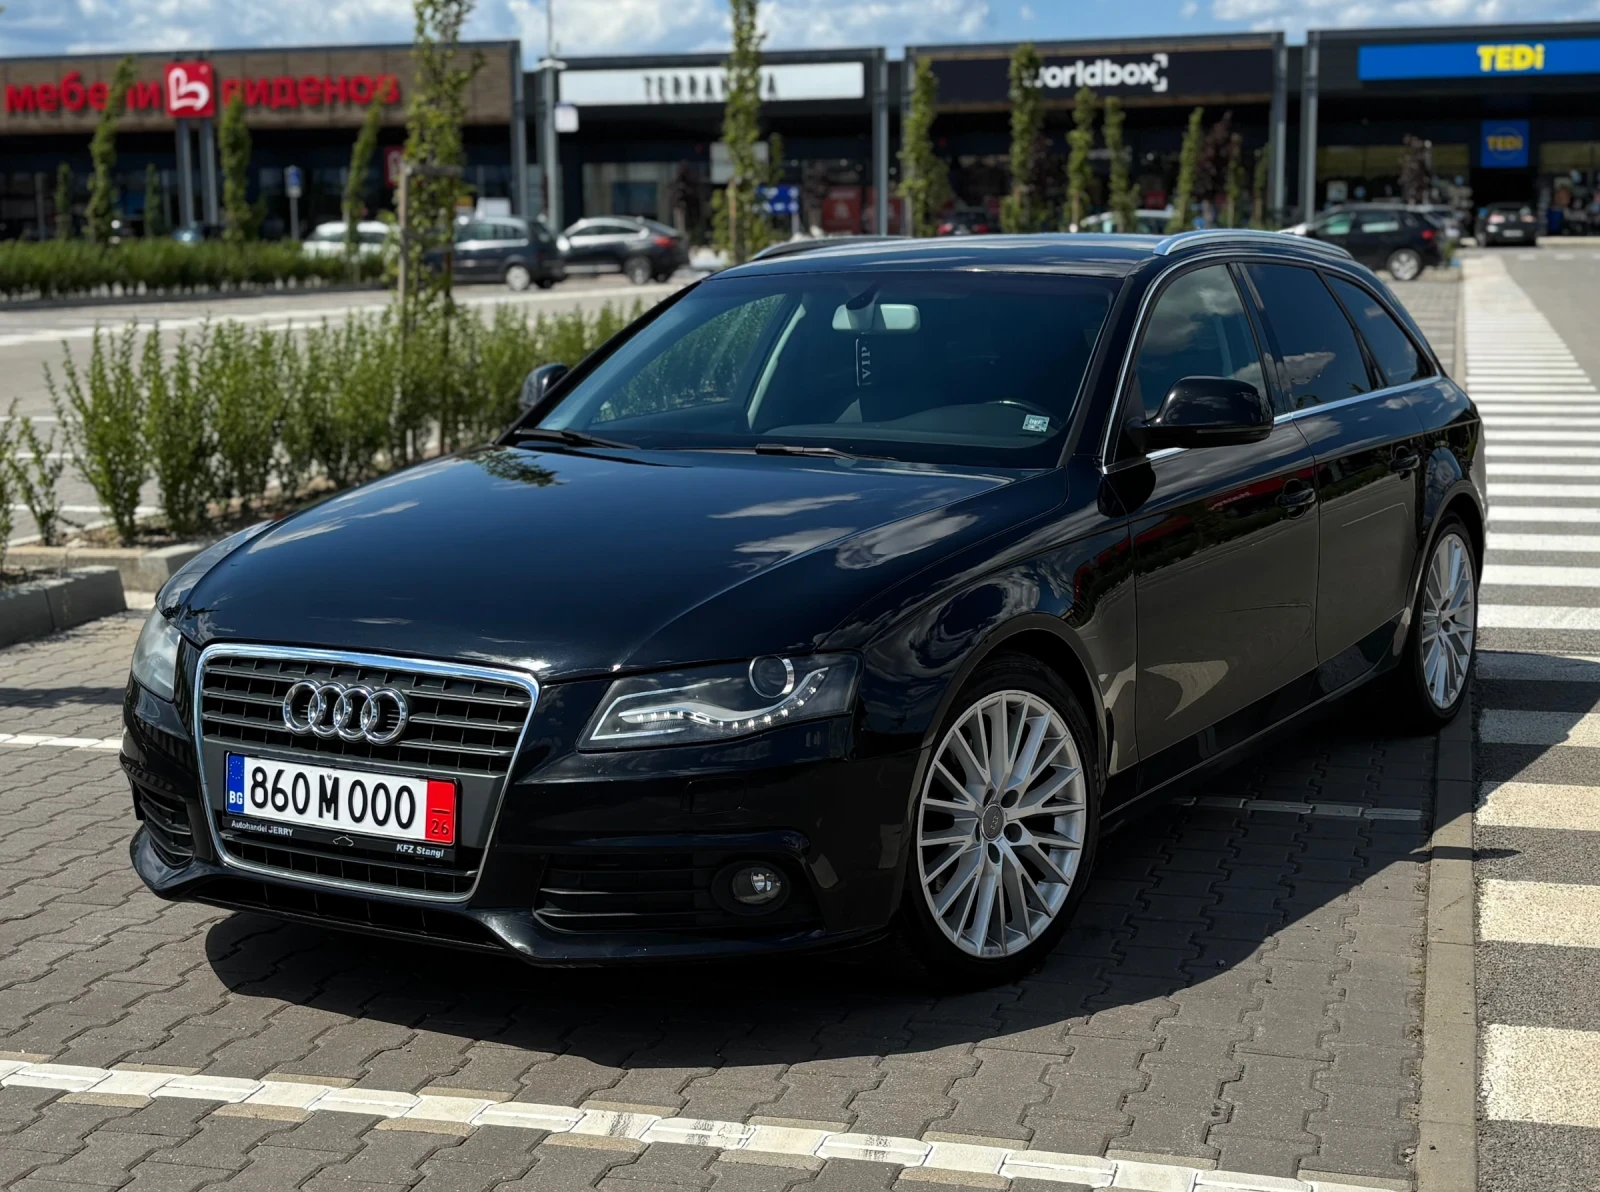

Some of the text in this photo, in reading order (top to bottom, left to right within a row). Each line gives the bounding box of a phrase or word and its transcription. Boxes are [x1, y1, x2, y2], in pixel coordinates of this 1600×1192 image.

[1477, 44, 1545, 71] TEDi
[643, 73, 779, 101] TERRAA
[229, 790, 243, 805] BG
[250, 766, 416, 830] 860 M 000
[231, 819, 294, 837] Autohandel JERRY
[431, 818, 450, 835] 26
[396, 843, 445, 859] KFZ Stangl
